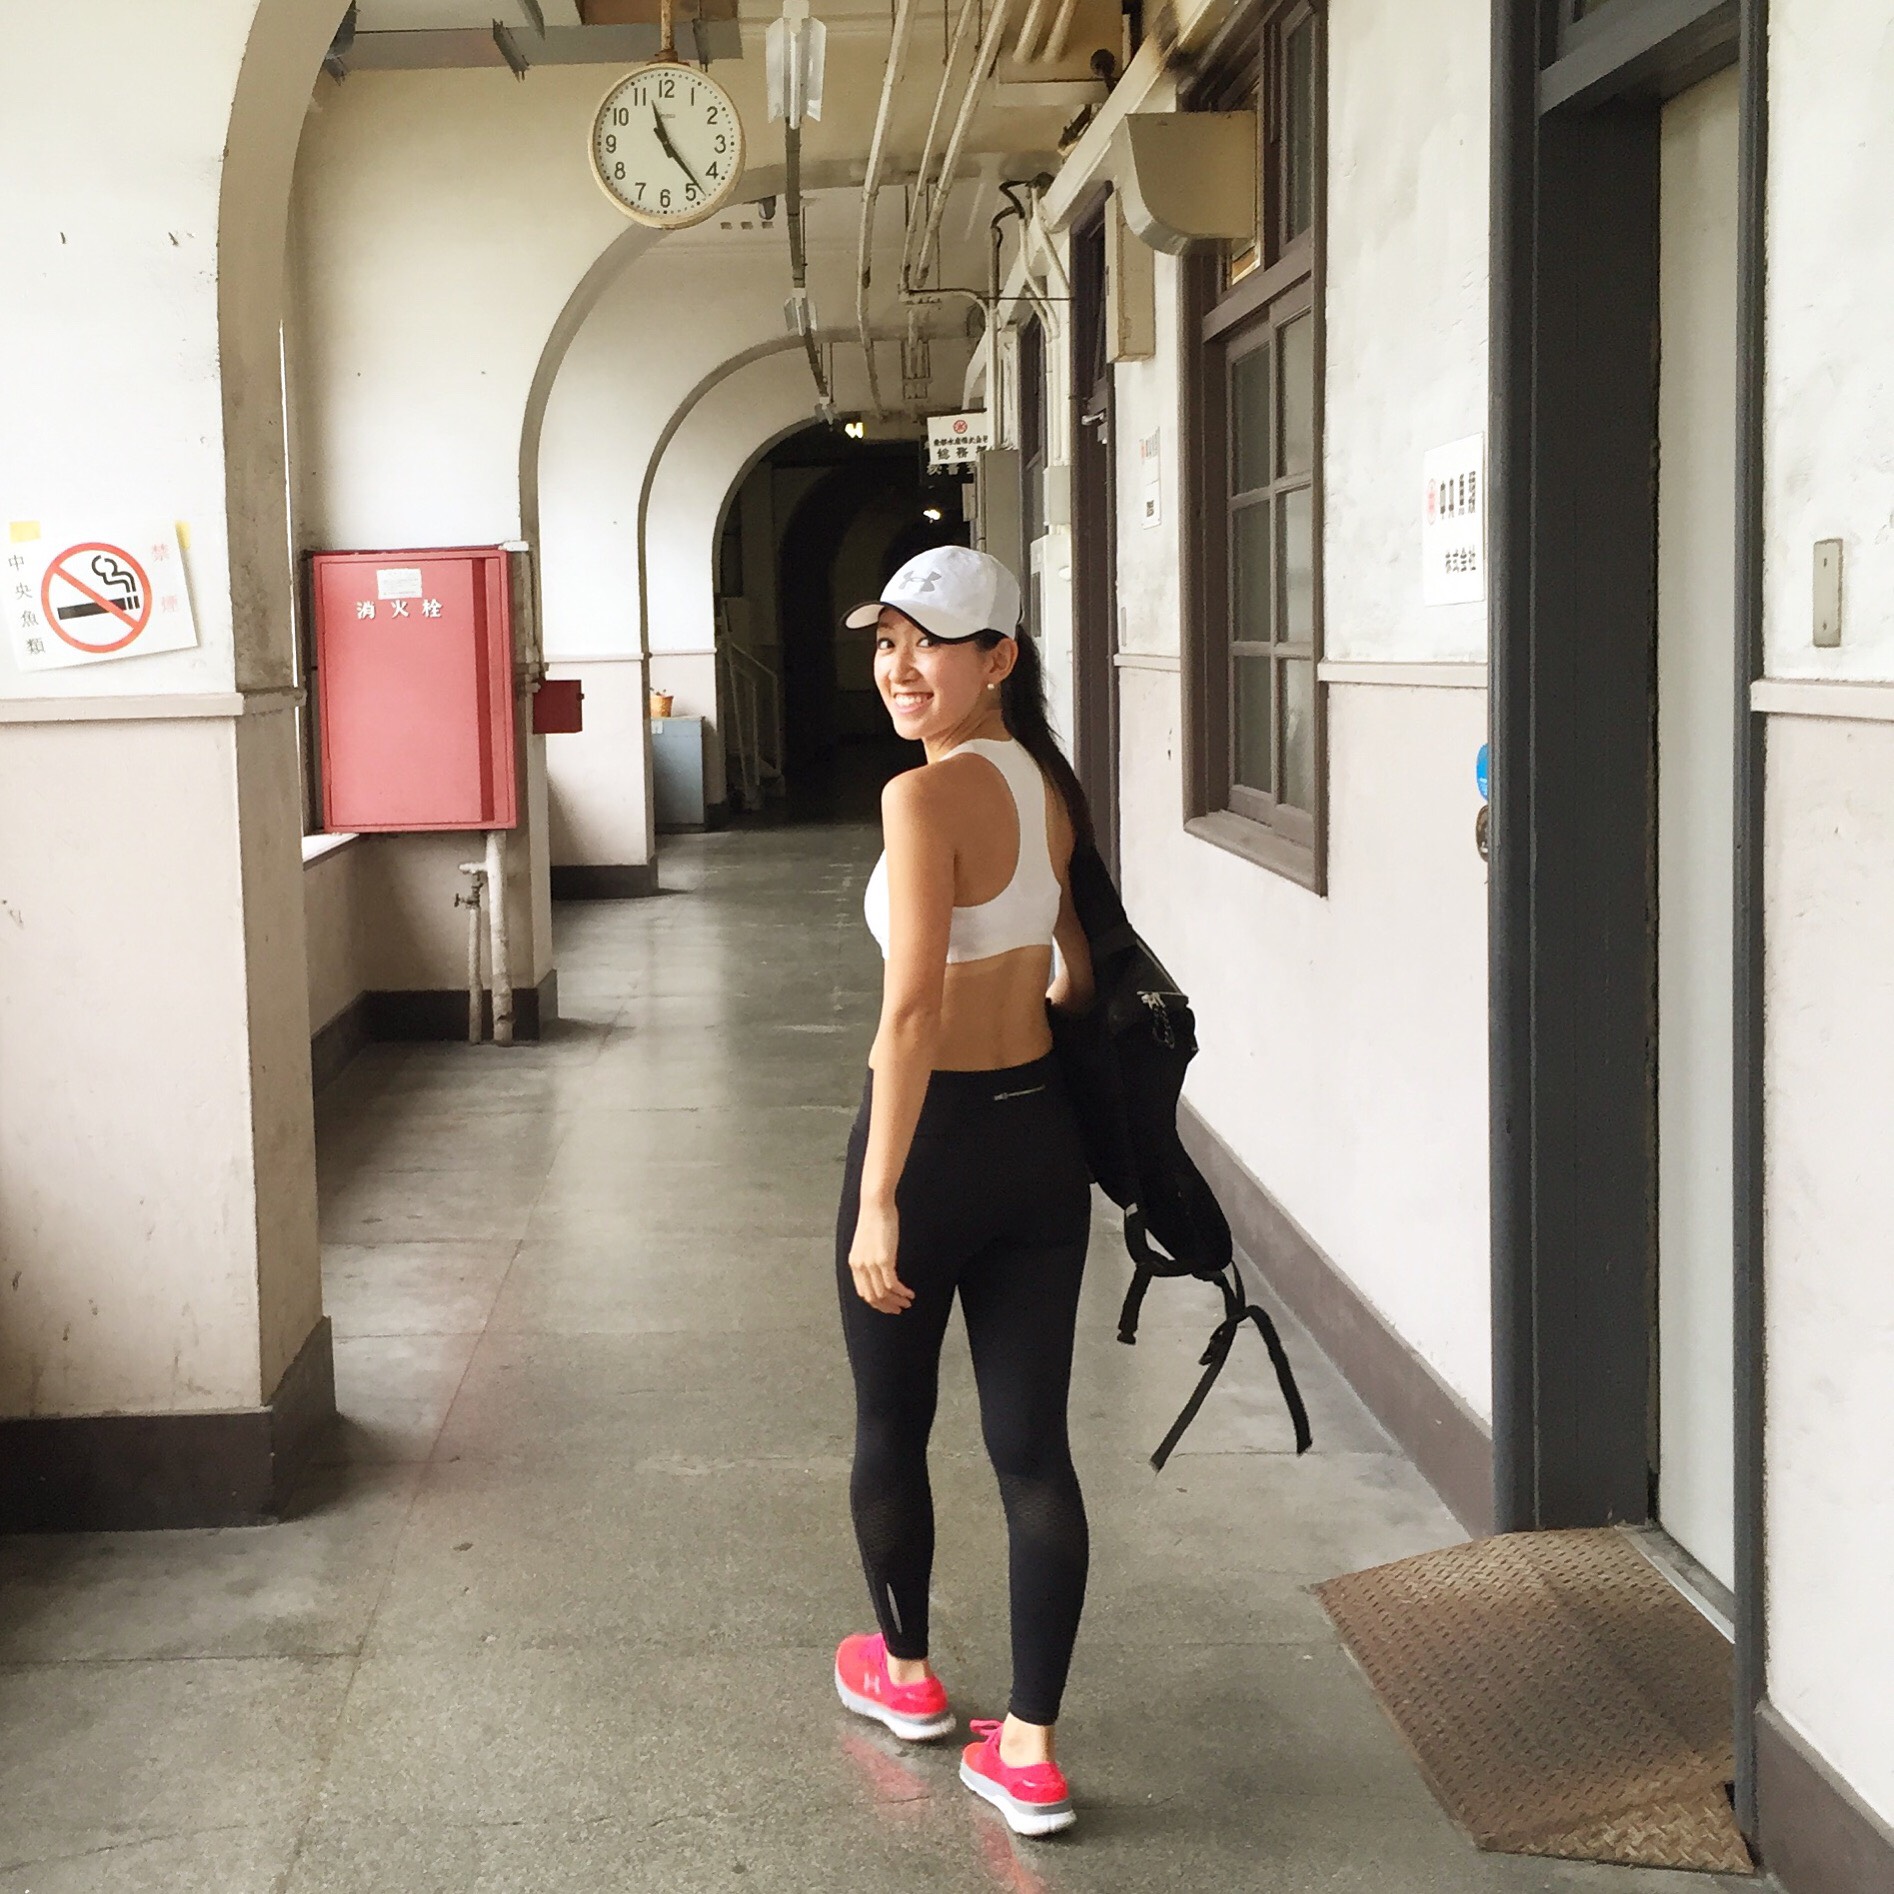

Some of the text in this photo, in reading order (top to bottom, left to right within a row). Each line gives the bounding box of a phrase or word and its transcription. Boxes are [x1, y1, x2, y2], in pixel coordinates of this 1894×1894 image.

[633, 87, 647, 107] 11
[658, 79, 675, 99] 12
[690, 86, 695, 107] 1
[613, 107, 630, 127] 10
[706, 106, 719, 125] 2
[605, 134, 617, 154] 9
[713, 134, 727, 154] 3
[613, 161, 626, 180] 8
[705, 160, 720, 180] 4
[634, 182, 647, 202] 7
[659, 188, 671, 209] 6
[685, 182, 698, 202] 5
[8, 554, 45, 655] 中央魚類
[356, 598, 443, 620] 消火栓
